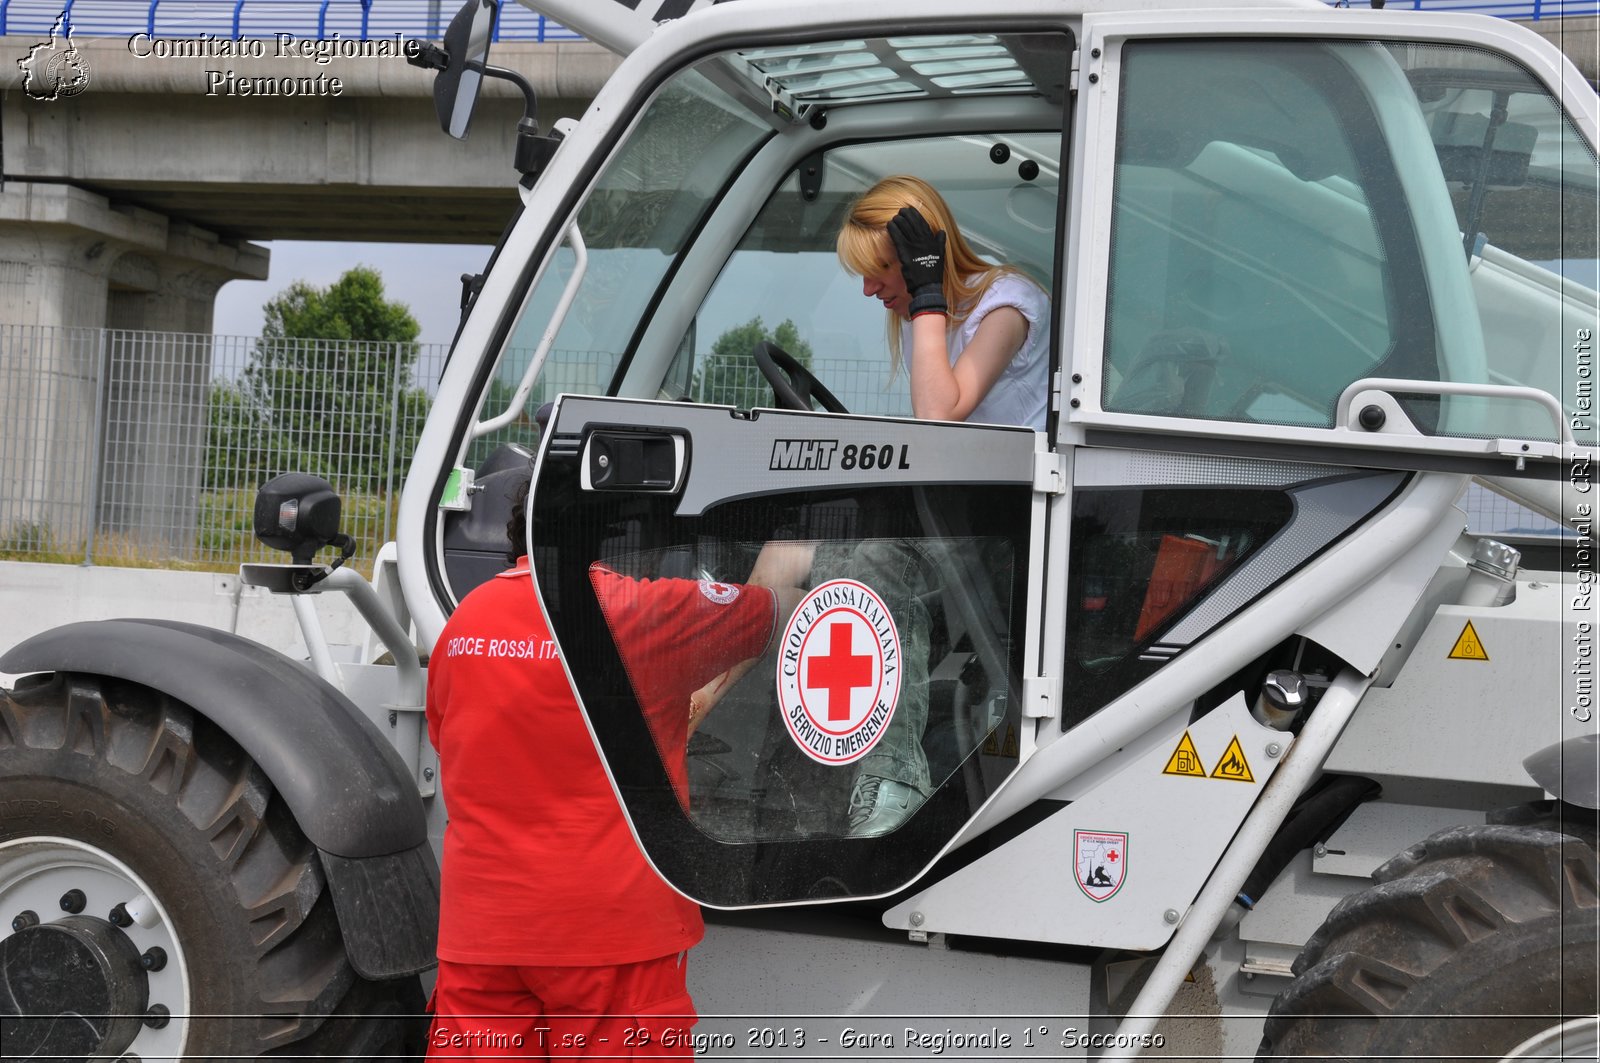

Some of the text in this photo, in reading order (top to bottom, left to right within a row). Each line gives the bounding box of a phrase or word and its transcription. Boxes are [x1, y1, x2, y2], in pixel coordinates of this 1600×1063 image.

[769, 439, 910, 471] MHT 860 L
[447, 636, 485, 657] CROCE
[488, 639, 534, 659] ROSSA
[783, 586, 897, 677] CROCE ROSSA ITALIANA
[790, 699, 890, 757] SERVIZIO EMERGENZE
